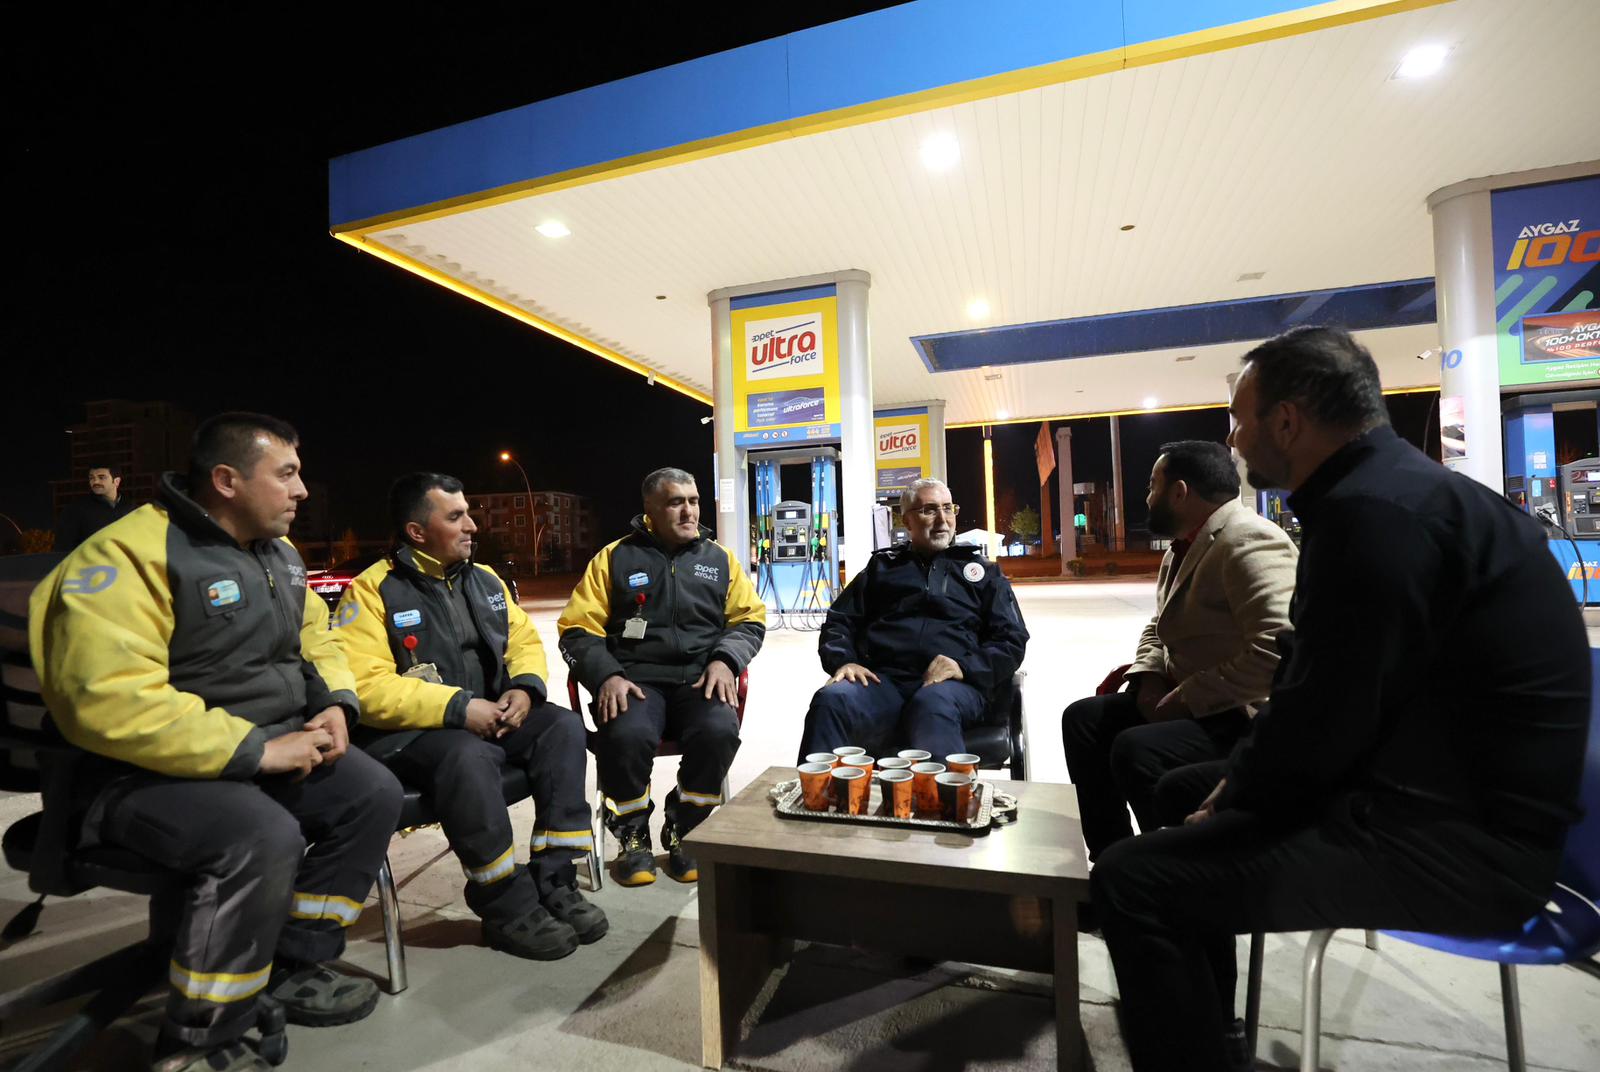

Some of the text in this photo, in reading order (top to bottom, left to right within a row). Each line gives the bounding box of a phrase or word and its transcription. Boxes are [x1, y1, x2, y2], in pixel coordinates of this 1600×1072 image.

[1518, 219, 1580, 239] AYGAZ
[752, 330, 775, 342] opet
[752, 331, 816, 366] ultra
[790, 351, 817, 365] force
[783, 400, 820, 414] ultraforce
[880, 433, 917, 451] ultra
[694, 563, 719, 575] opet
[694, 571, 719, 581] AYGAZ
[487, 592, 504, 604] pet
